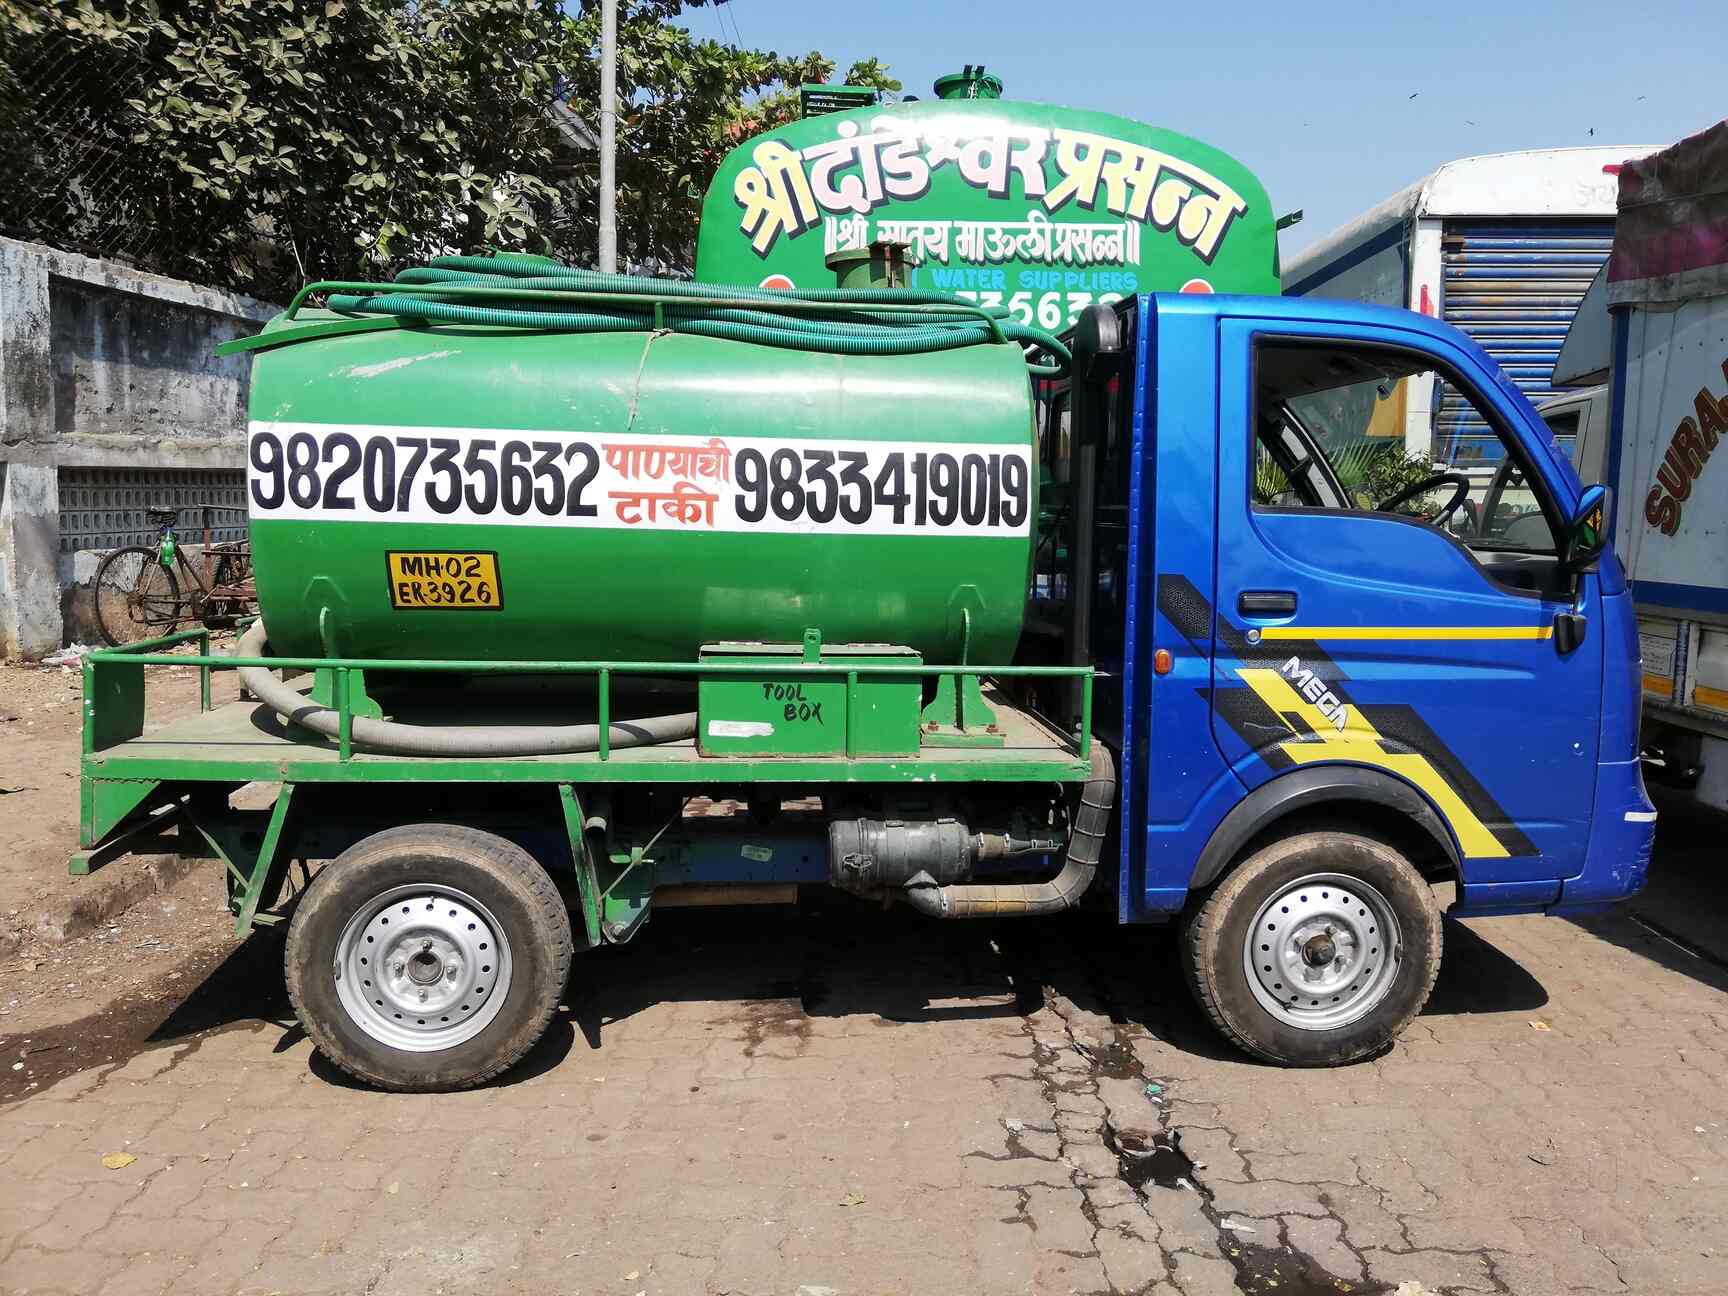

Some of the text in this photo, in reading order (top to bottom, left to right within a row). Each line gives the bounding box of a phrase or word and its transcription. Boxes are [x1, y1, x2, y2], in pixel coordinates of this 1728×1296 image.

[734, 140, 822, 256] श्री
[1042, 127, 1248, 264] प्रसन्न
[931, 268, 1007, 291] WATER
[1018, 270, 1139, 291] SUPPLIERS
[249, 432, 600, 517] 9820735632
[608, 481, 720, 528] टाकी
[735, 447, 1029, 528] 9833419019
[762, 683, 807, 701] TOOL
[783, 702, 824, 727] BOX
[1281, 655, 1349, 733] MEGA
